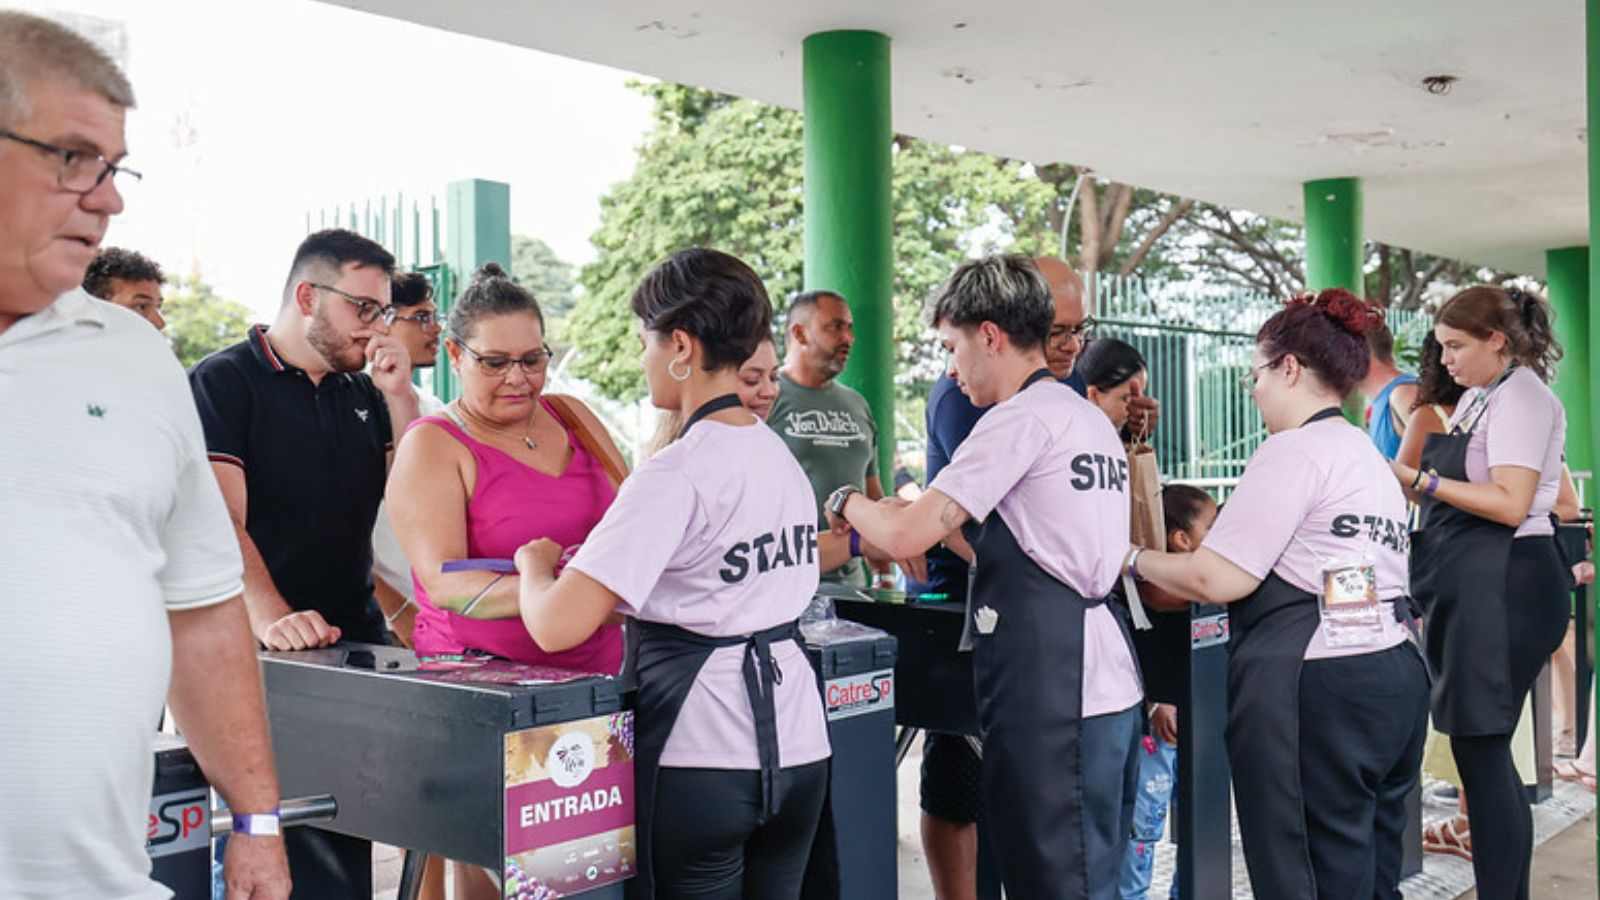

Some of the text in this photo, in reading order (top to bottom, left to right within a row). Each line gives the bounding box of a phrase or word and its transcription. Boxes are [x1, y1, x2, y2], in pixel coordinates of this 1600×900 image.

[1070, 453, 1127, 493] STAF
[1330, 514, 1408, 552] STAF
[720, 524, 817, 584] STAFF
[519, 785, 623, 828] ENTRADA
